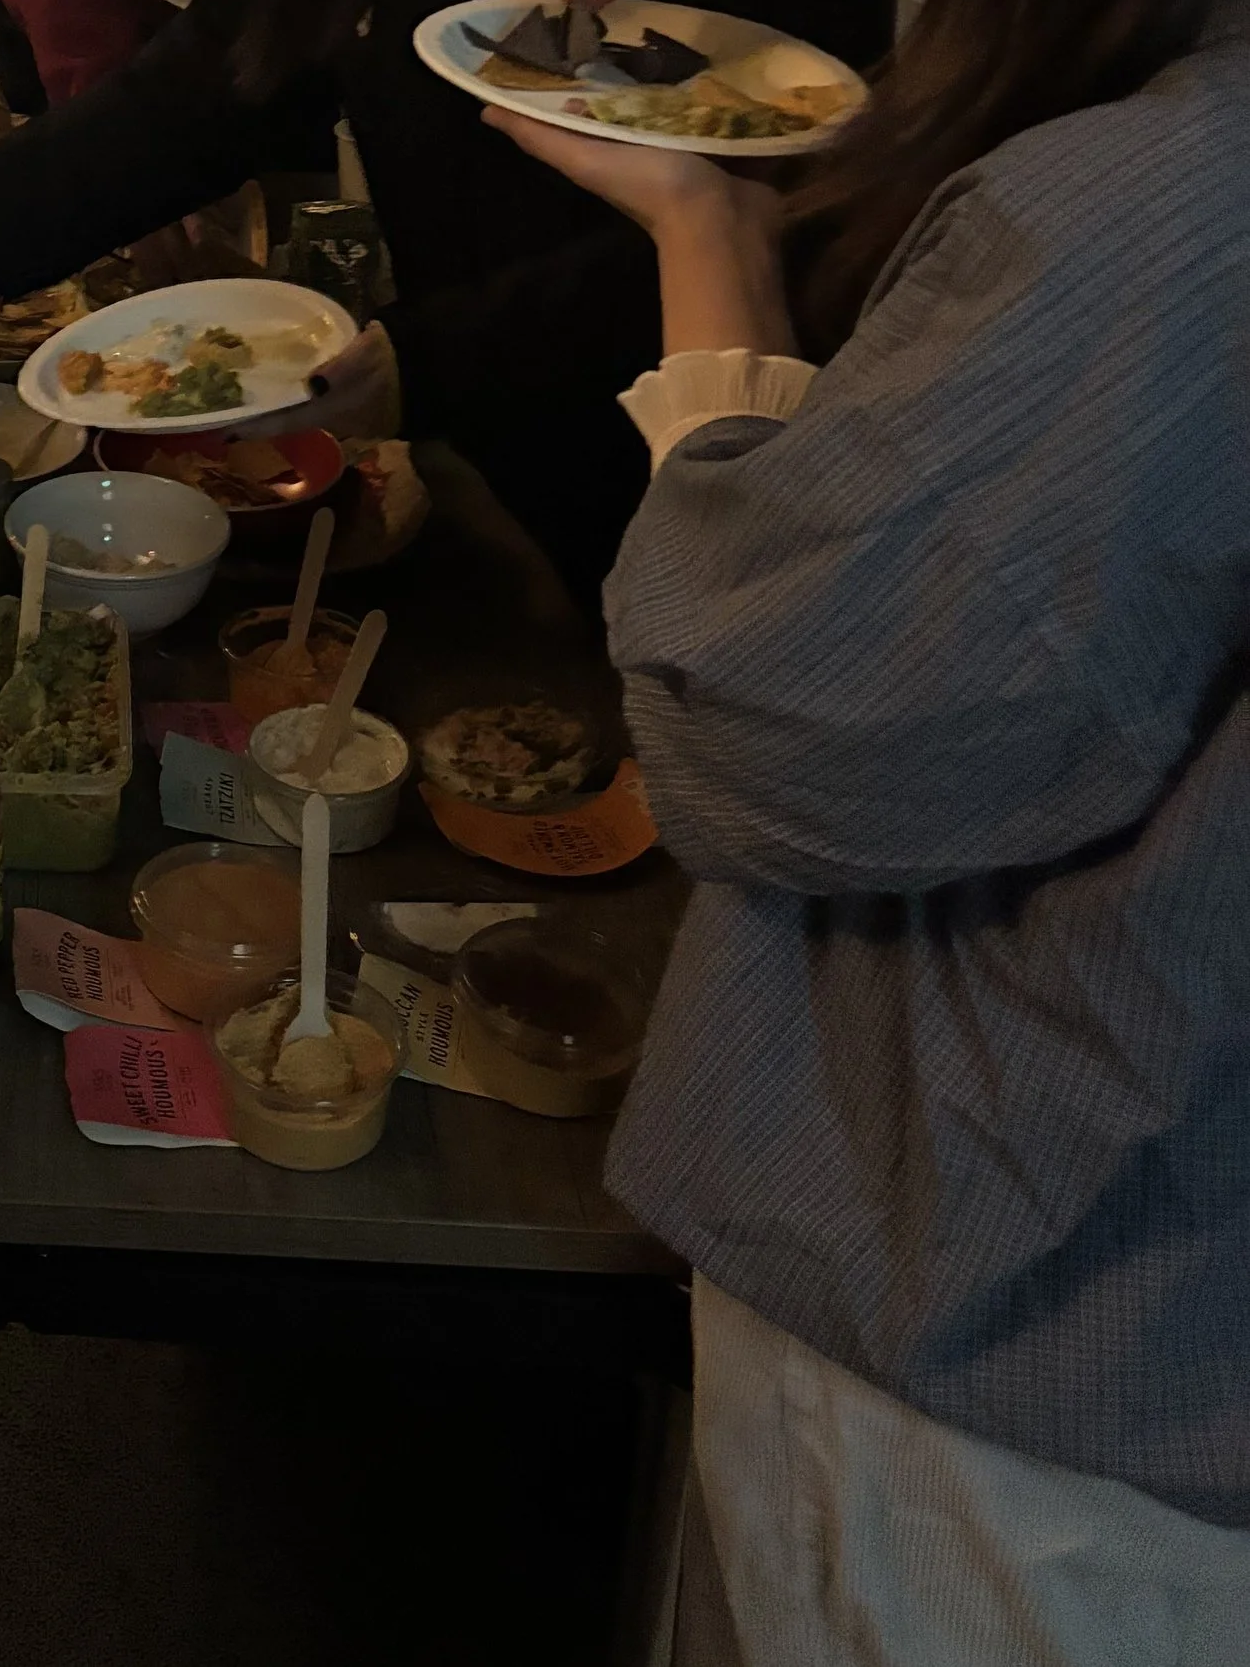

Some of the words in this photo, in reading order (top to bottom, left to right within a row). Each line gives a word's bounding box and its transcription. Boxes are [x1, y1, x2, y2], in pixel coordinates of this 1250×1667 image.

[218, 772, 235, 824] TZATZIKI
[57, 931, 81, 975] PEPPER
[82, 945, 105, 1002] HOUMOUS
[62, 977, 84, 1000] RED
[119, 1035, 143, 1080] CHILLI
[428, 1002, 454, 1068] HOUMOUS
[122, 1082, 158, 1126] SWEET
[146, 1049, 178, 1119] HOUMOUS
